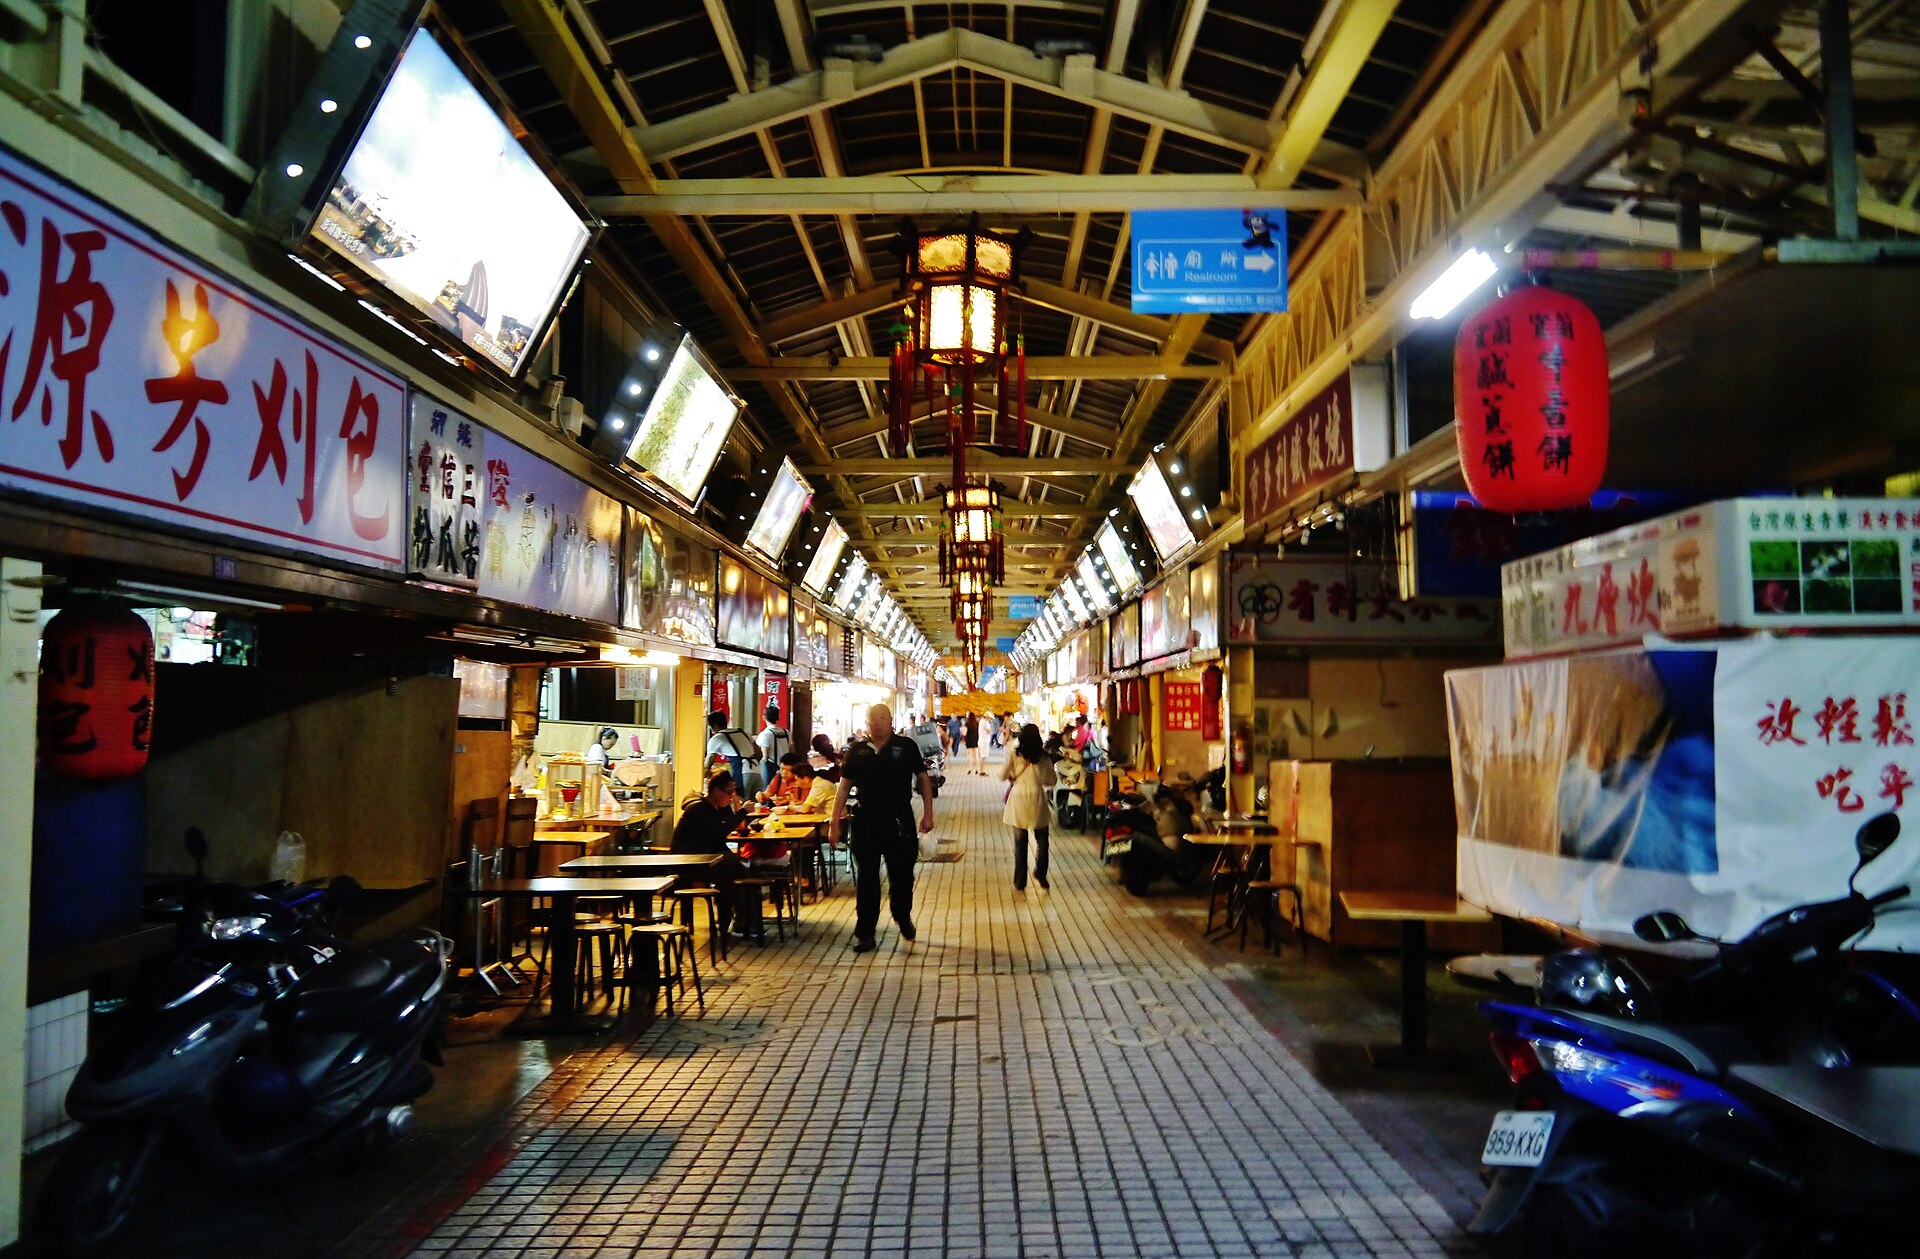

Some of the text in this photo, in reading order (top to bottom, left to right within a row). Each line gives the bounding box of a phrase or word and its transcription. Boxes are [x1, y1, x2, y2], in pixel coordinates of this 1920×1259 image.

[1185, 271, 1238, 282] Restroom
[1757, 693, 1916, 747] 放輕鬆
